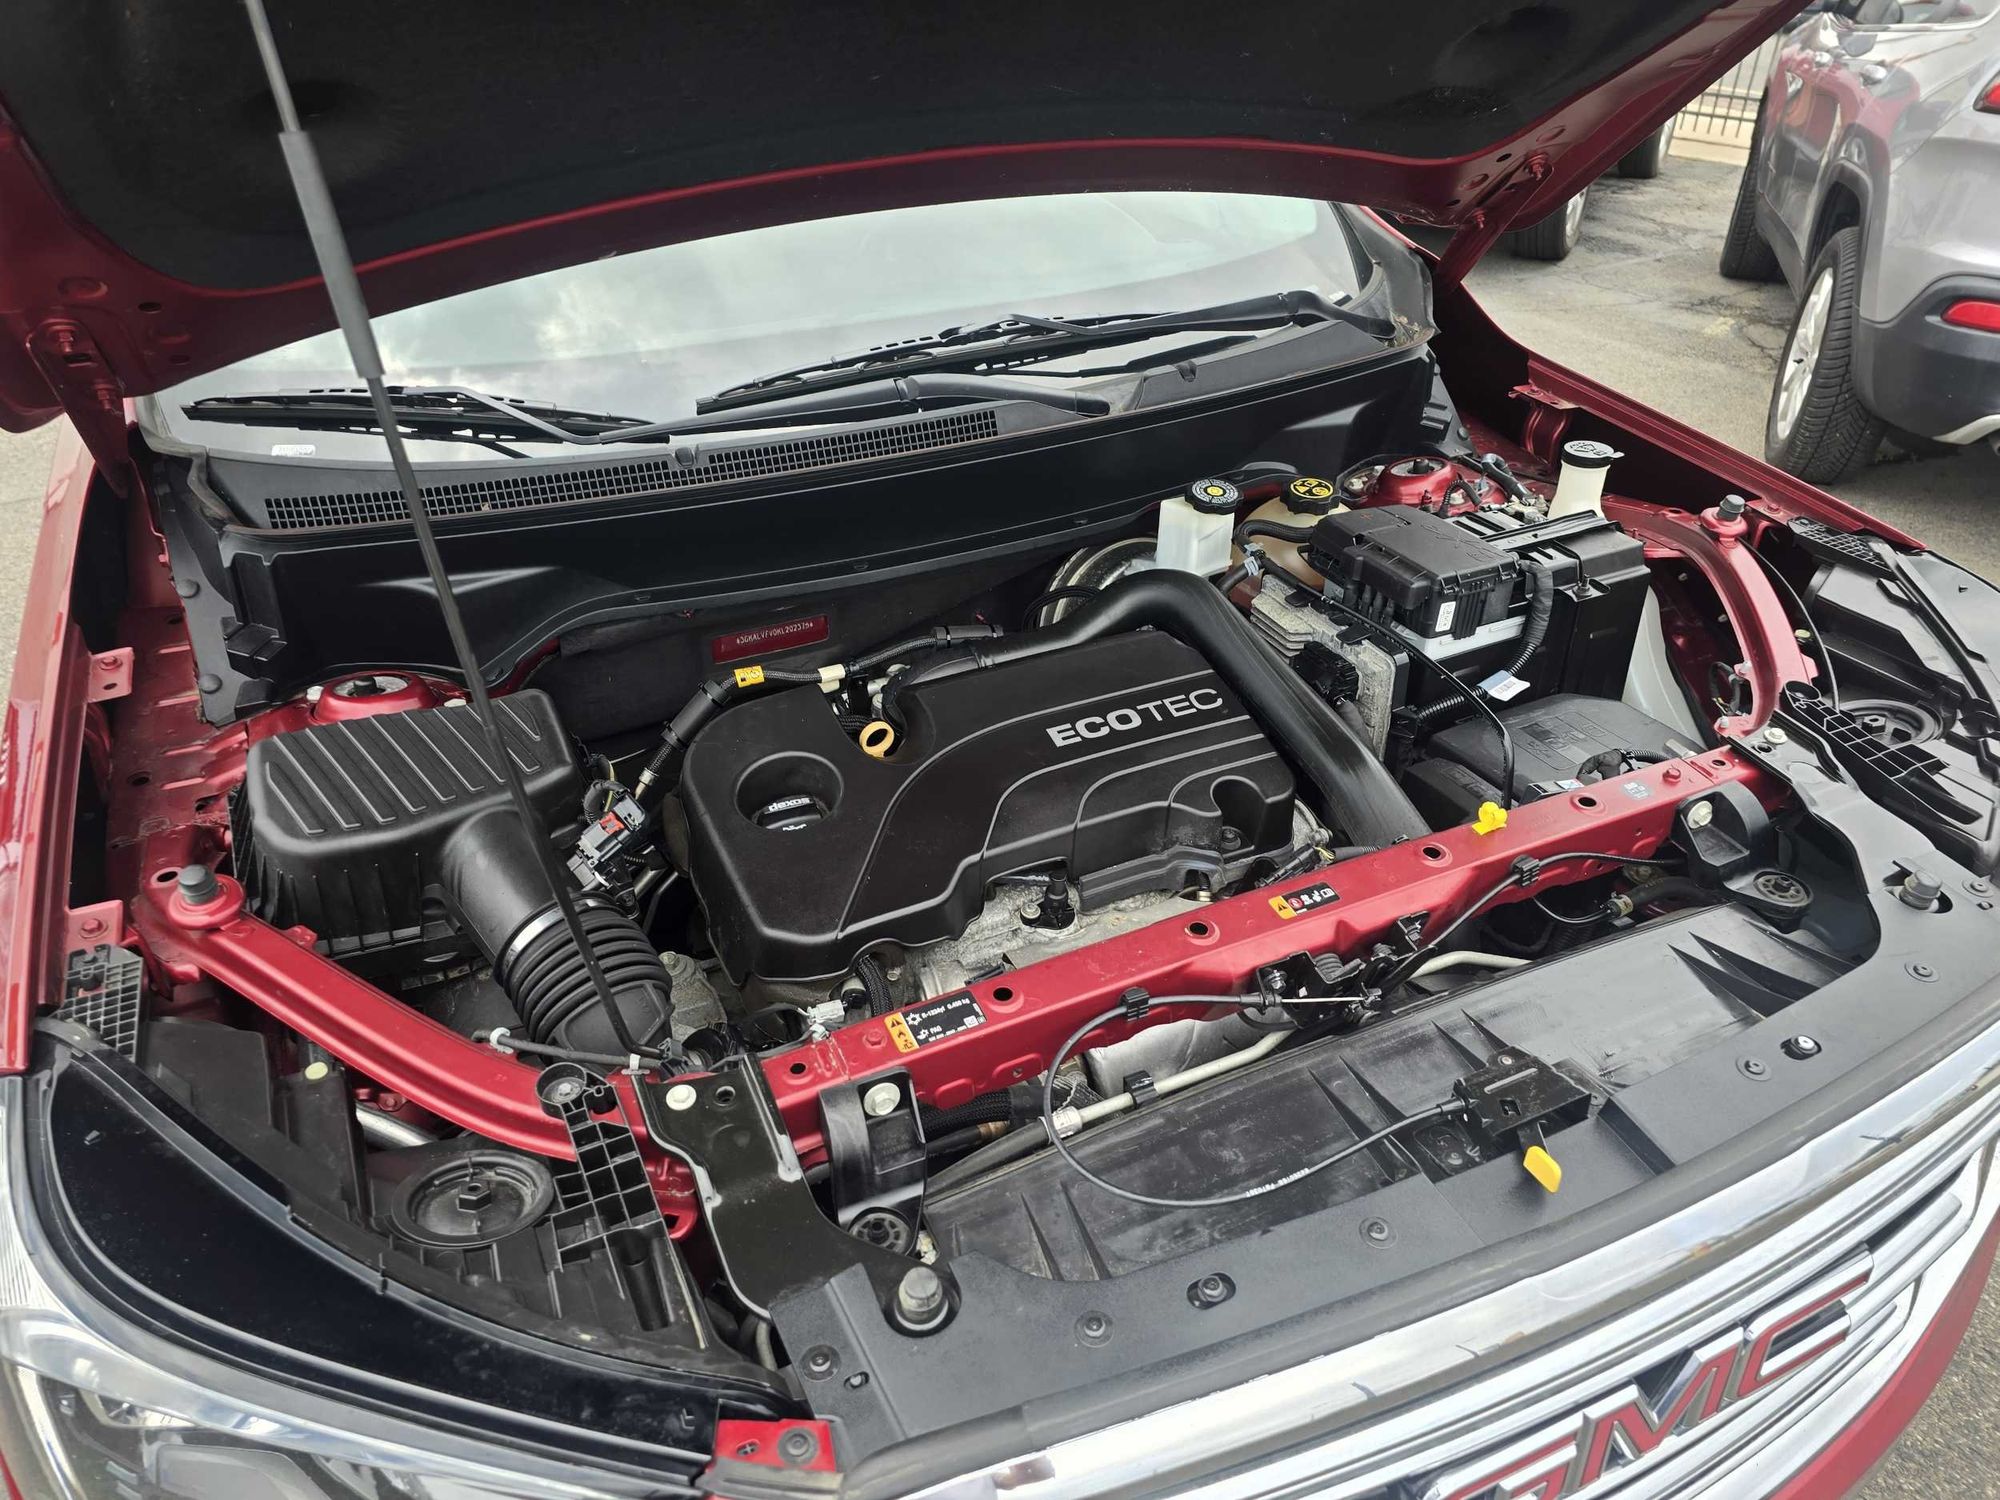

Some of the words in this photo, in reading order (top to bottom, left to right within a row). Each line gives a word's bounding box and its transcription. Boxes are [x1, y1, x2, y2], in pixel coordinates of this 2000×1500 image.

[1045, 688, 1223, 747] ECOTEC
[768, 797, 810, 812] dexos
[1425, 1245, 1874, 1500] GMC
